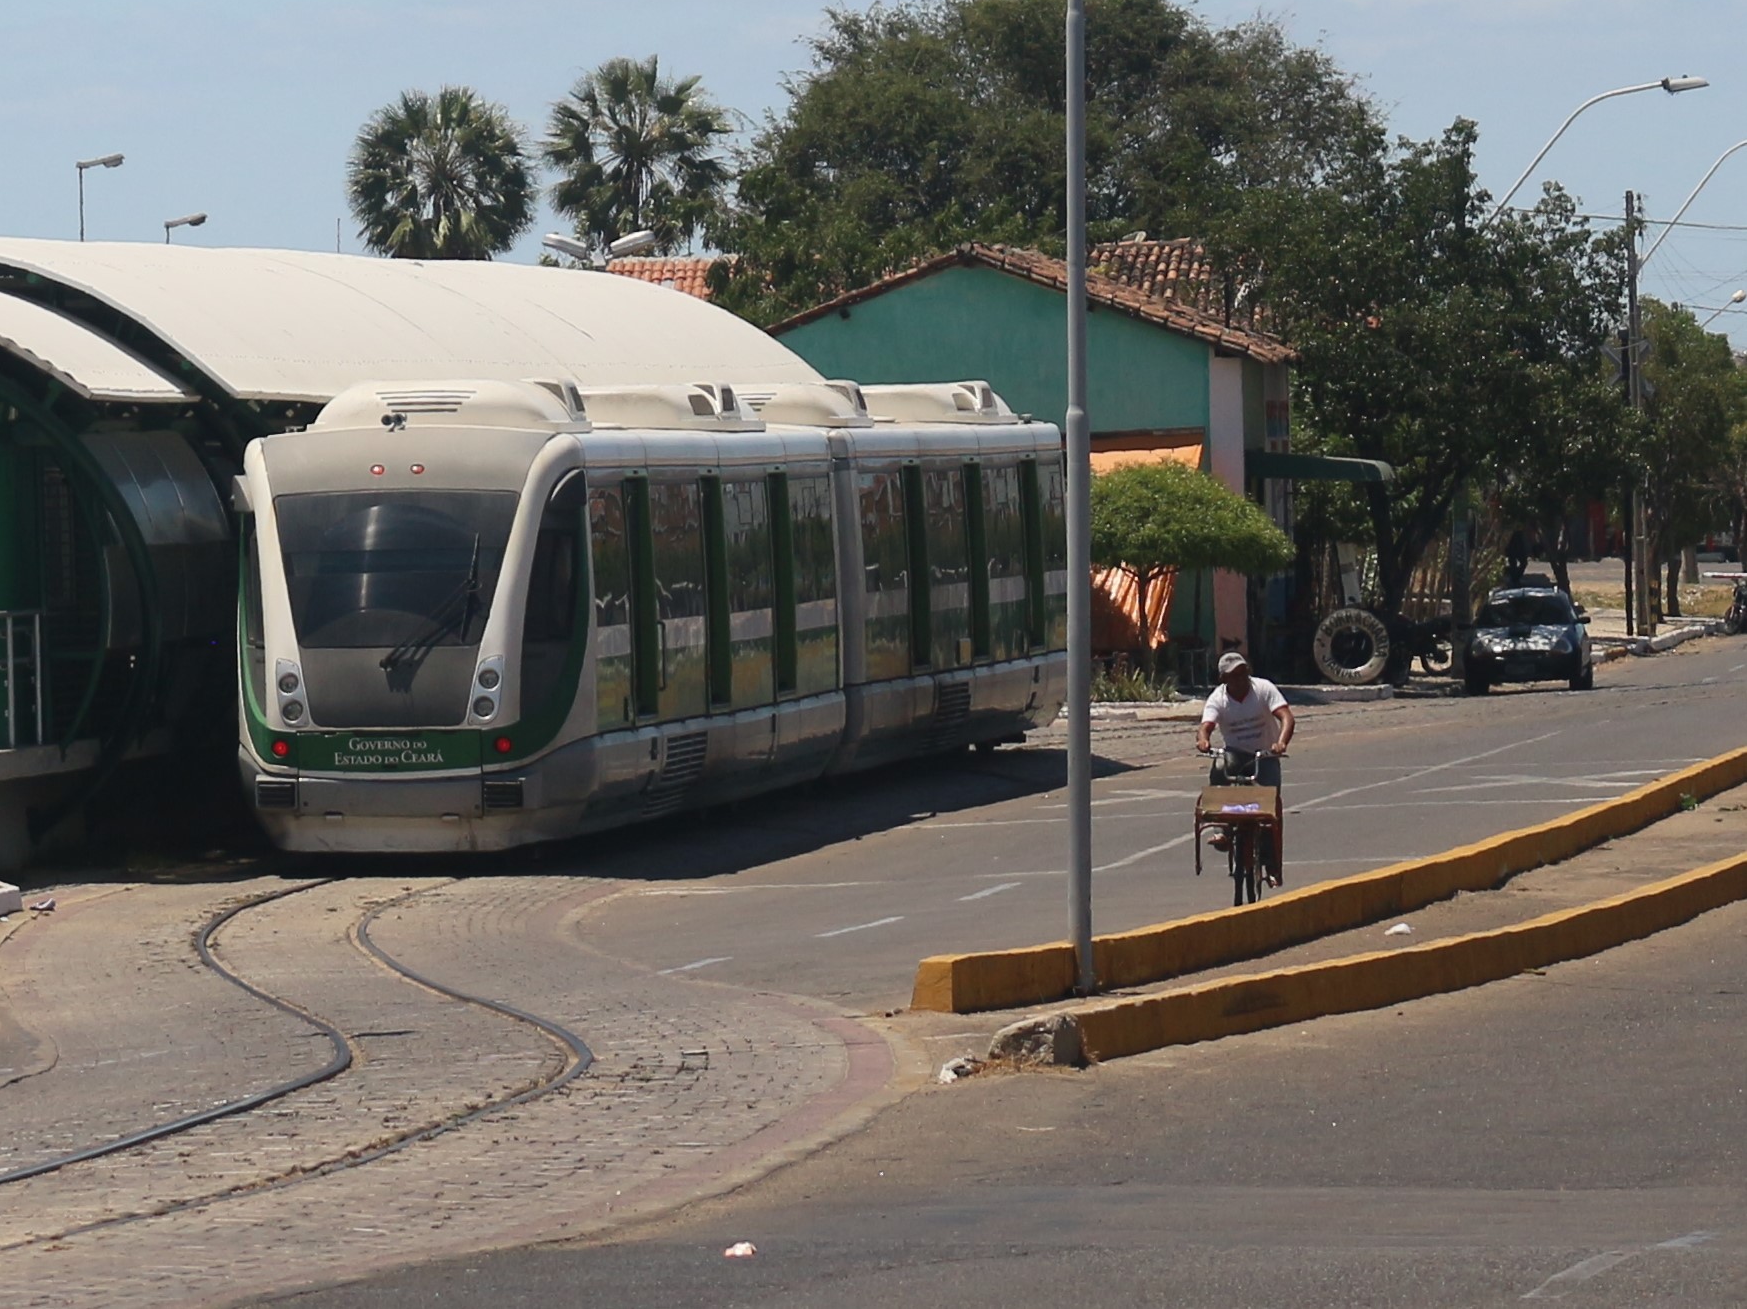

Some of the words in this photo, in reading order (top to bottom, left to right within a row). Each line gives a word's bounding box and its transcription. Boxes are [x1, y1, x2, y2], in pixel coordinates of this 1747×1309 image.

[348, 737, 410, 751] GOVERNO
[334, 752, 382, 765] ESTADO
[401, 749, 444, 763] CEARÁ
